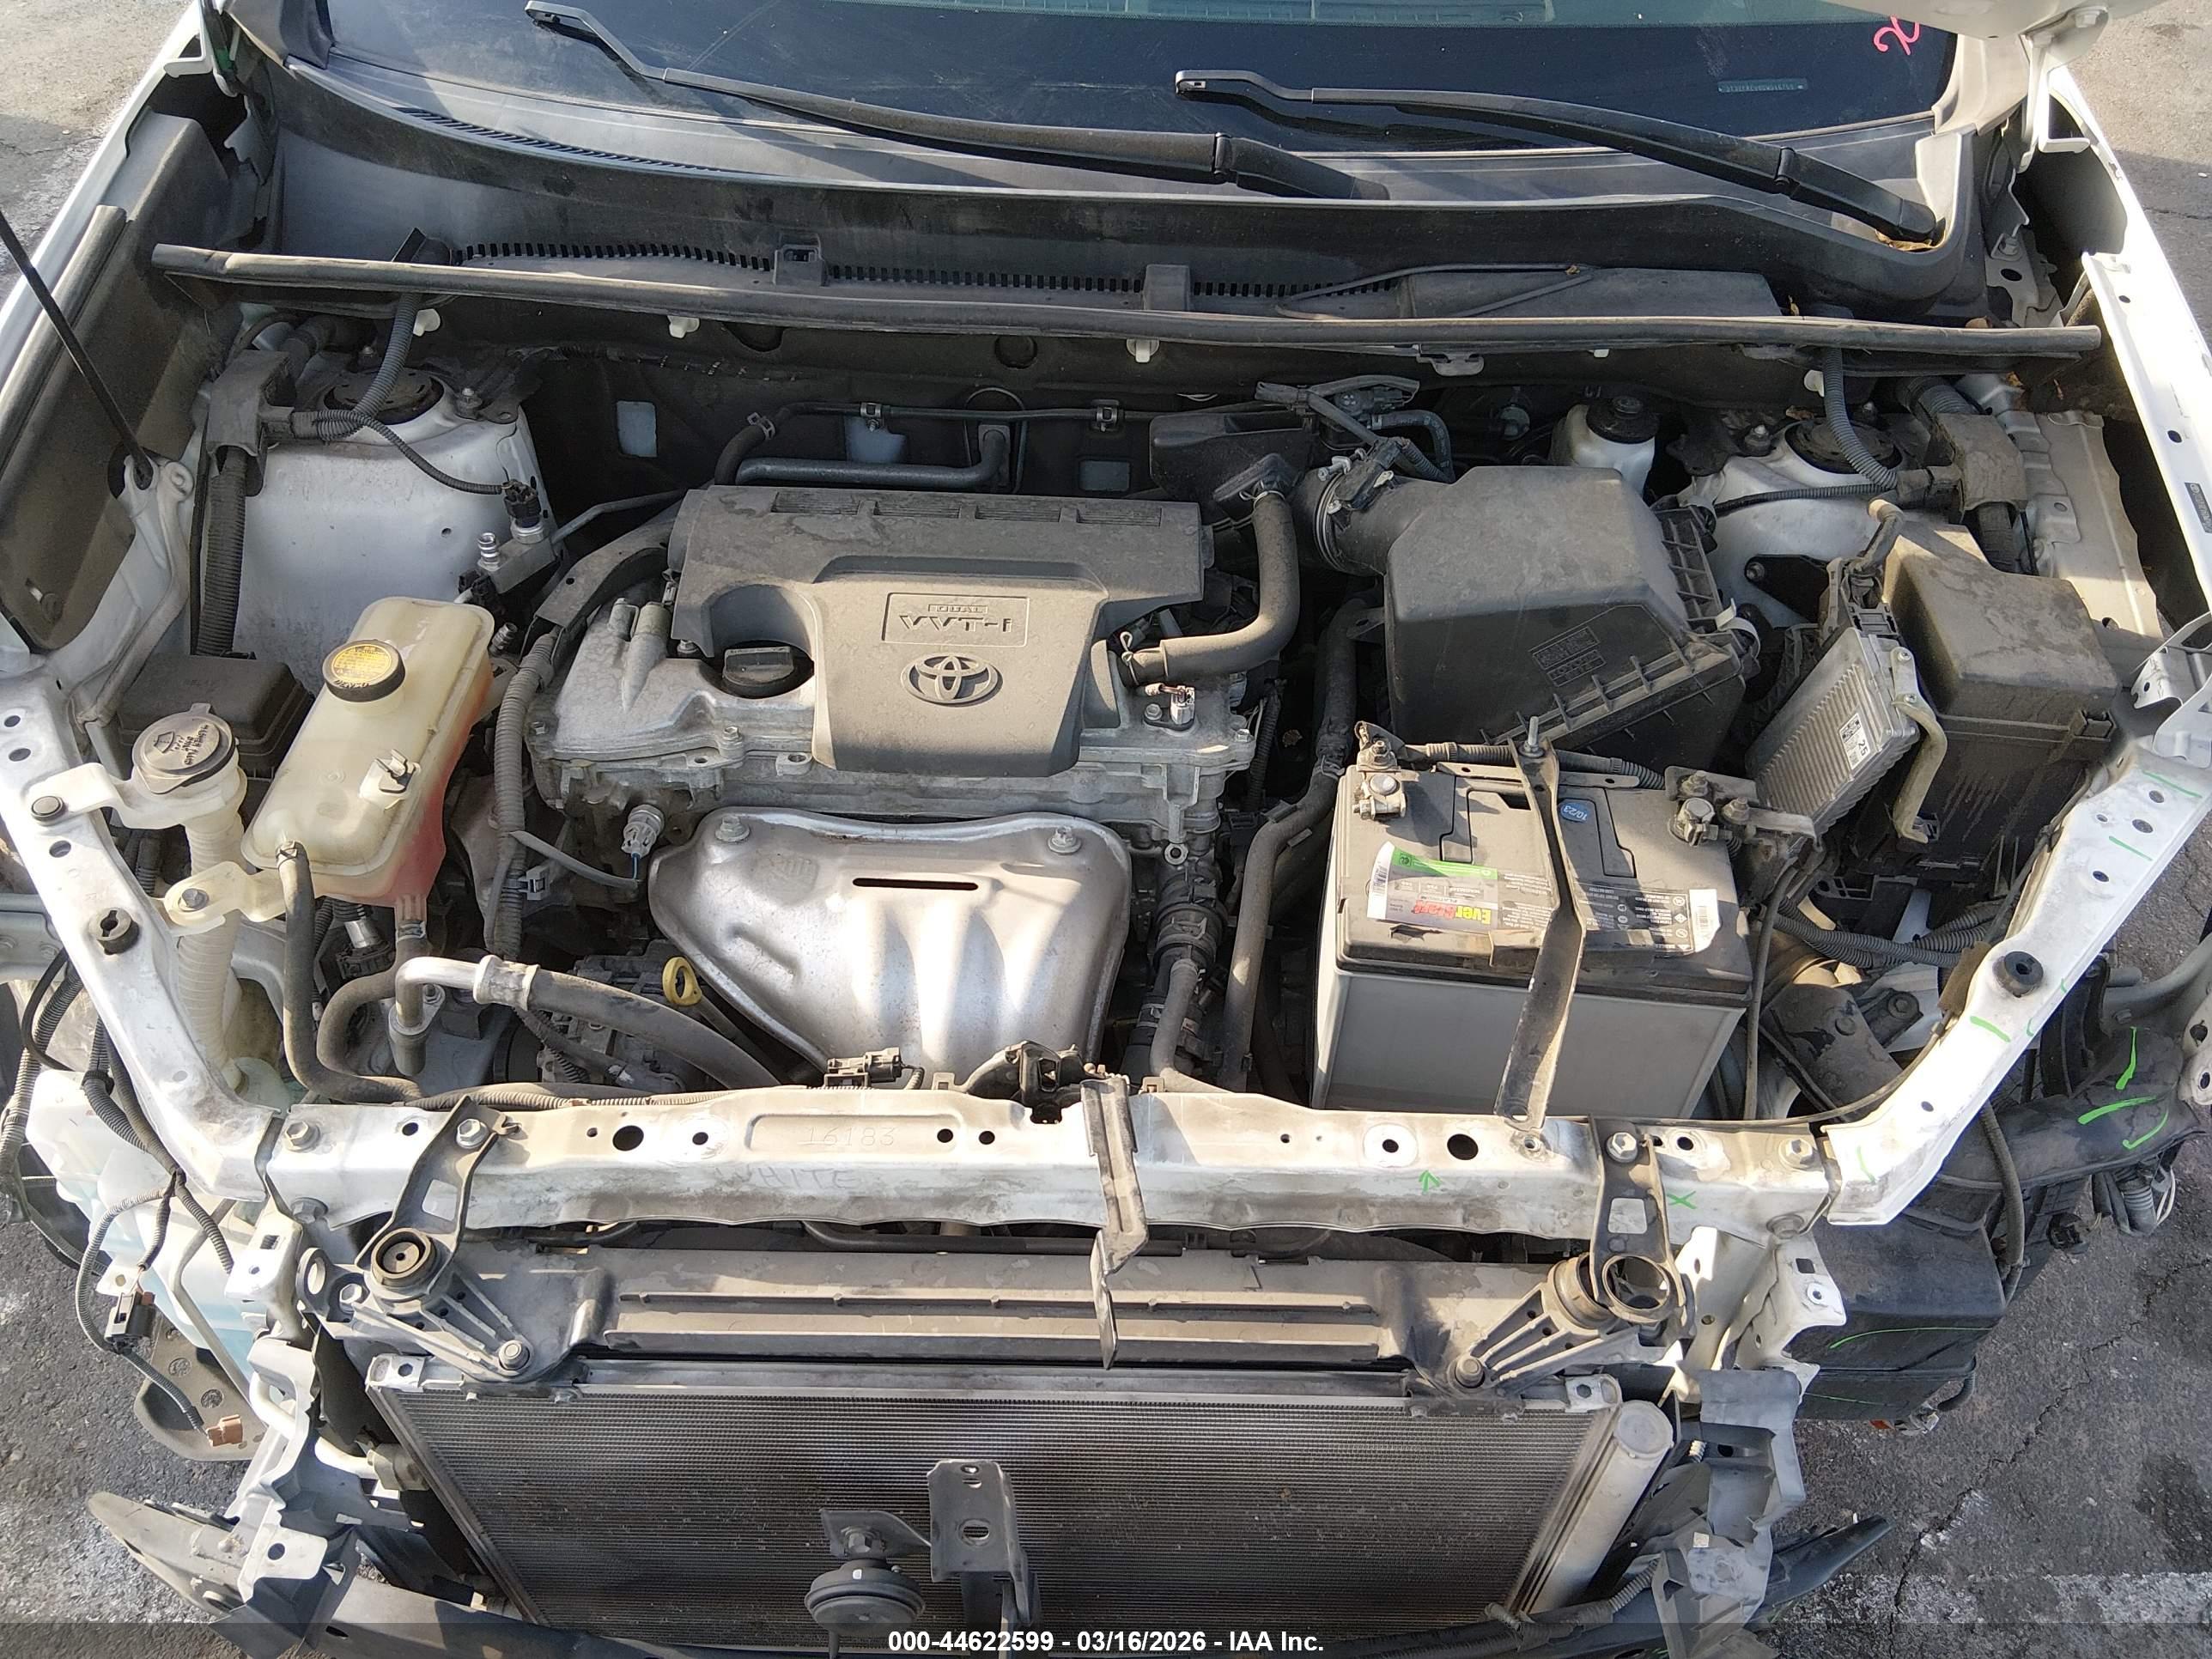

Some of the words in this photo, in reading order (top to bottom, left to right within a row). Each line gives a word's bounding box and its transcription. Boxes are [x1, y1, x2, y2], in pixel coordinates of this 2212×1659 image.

[899, 614, 1013, 633] VVT-i
[1563, 804, 1589, 822] 10/23
[1413, 900, 1492, 925] EverStart
[808, 1126, 897, 1147] 16183
